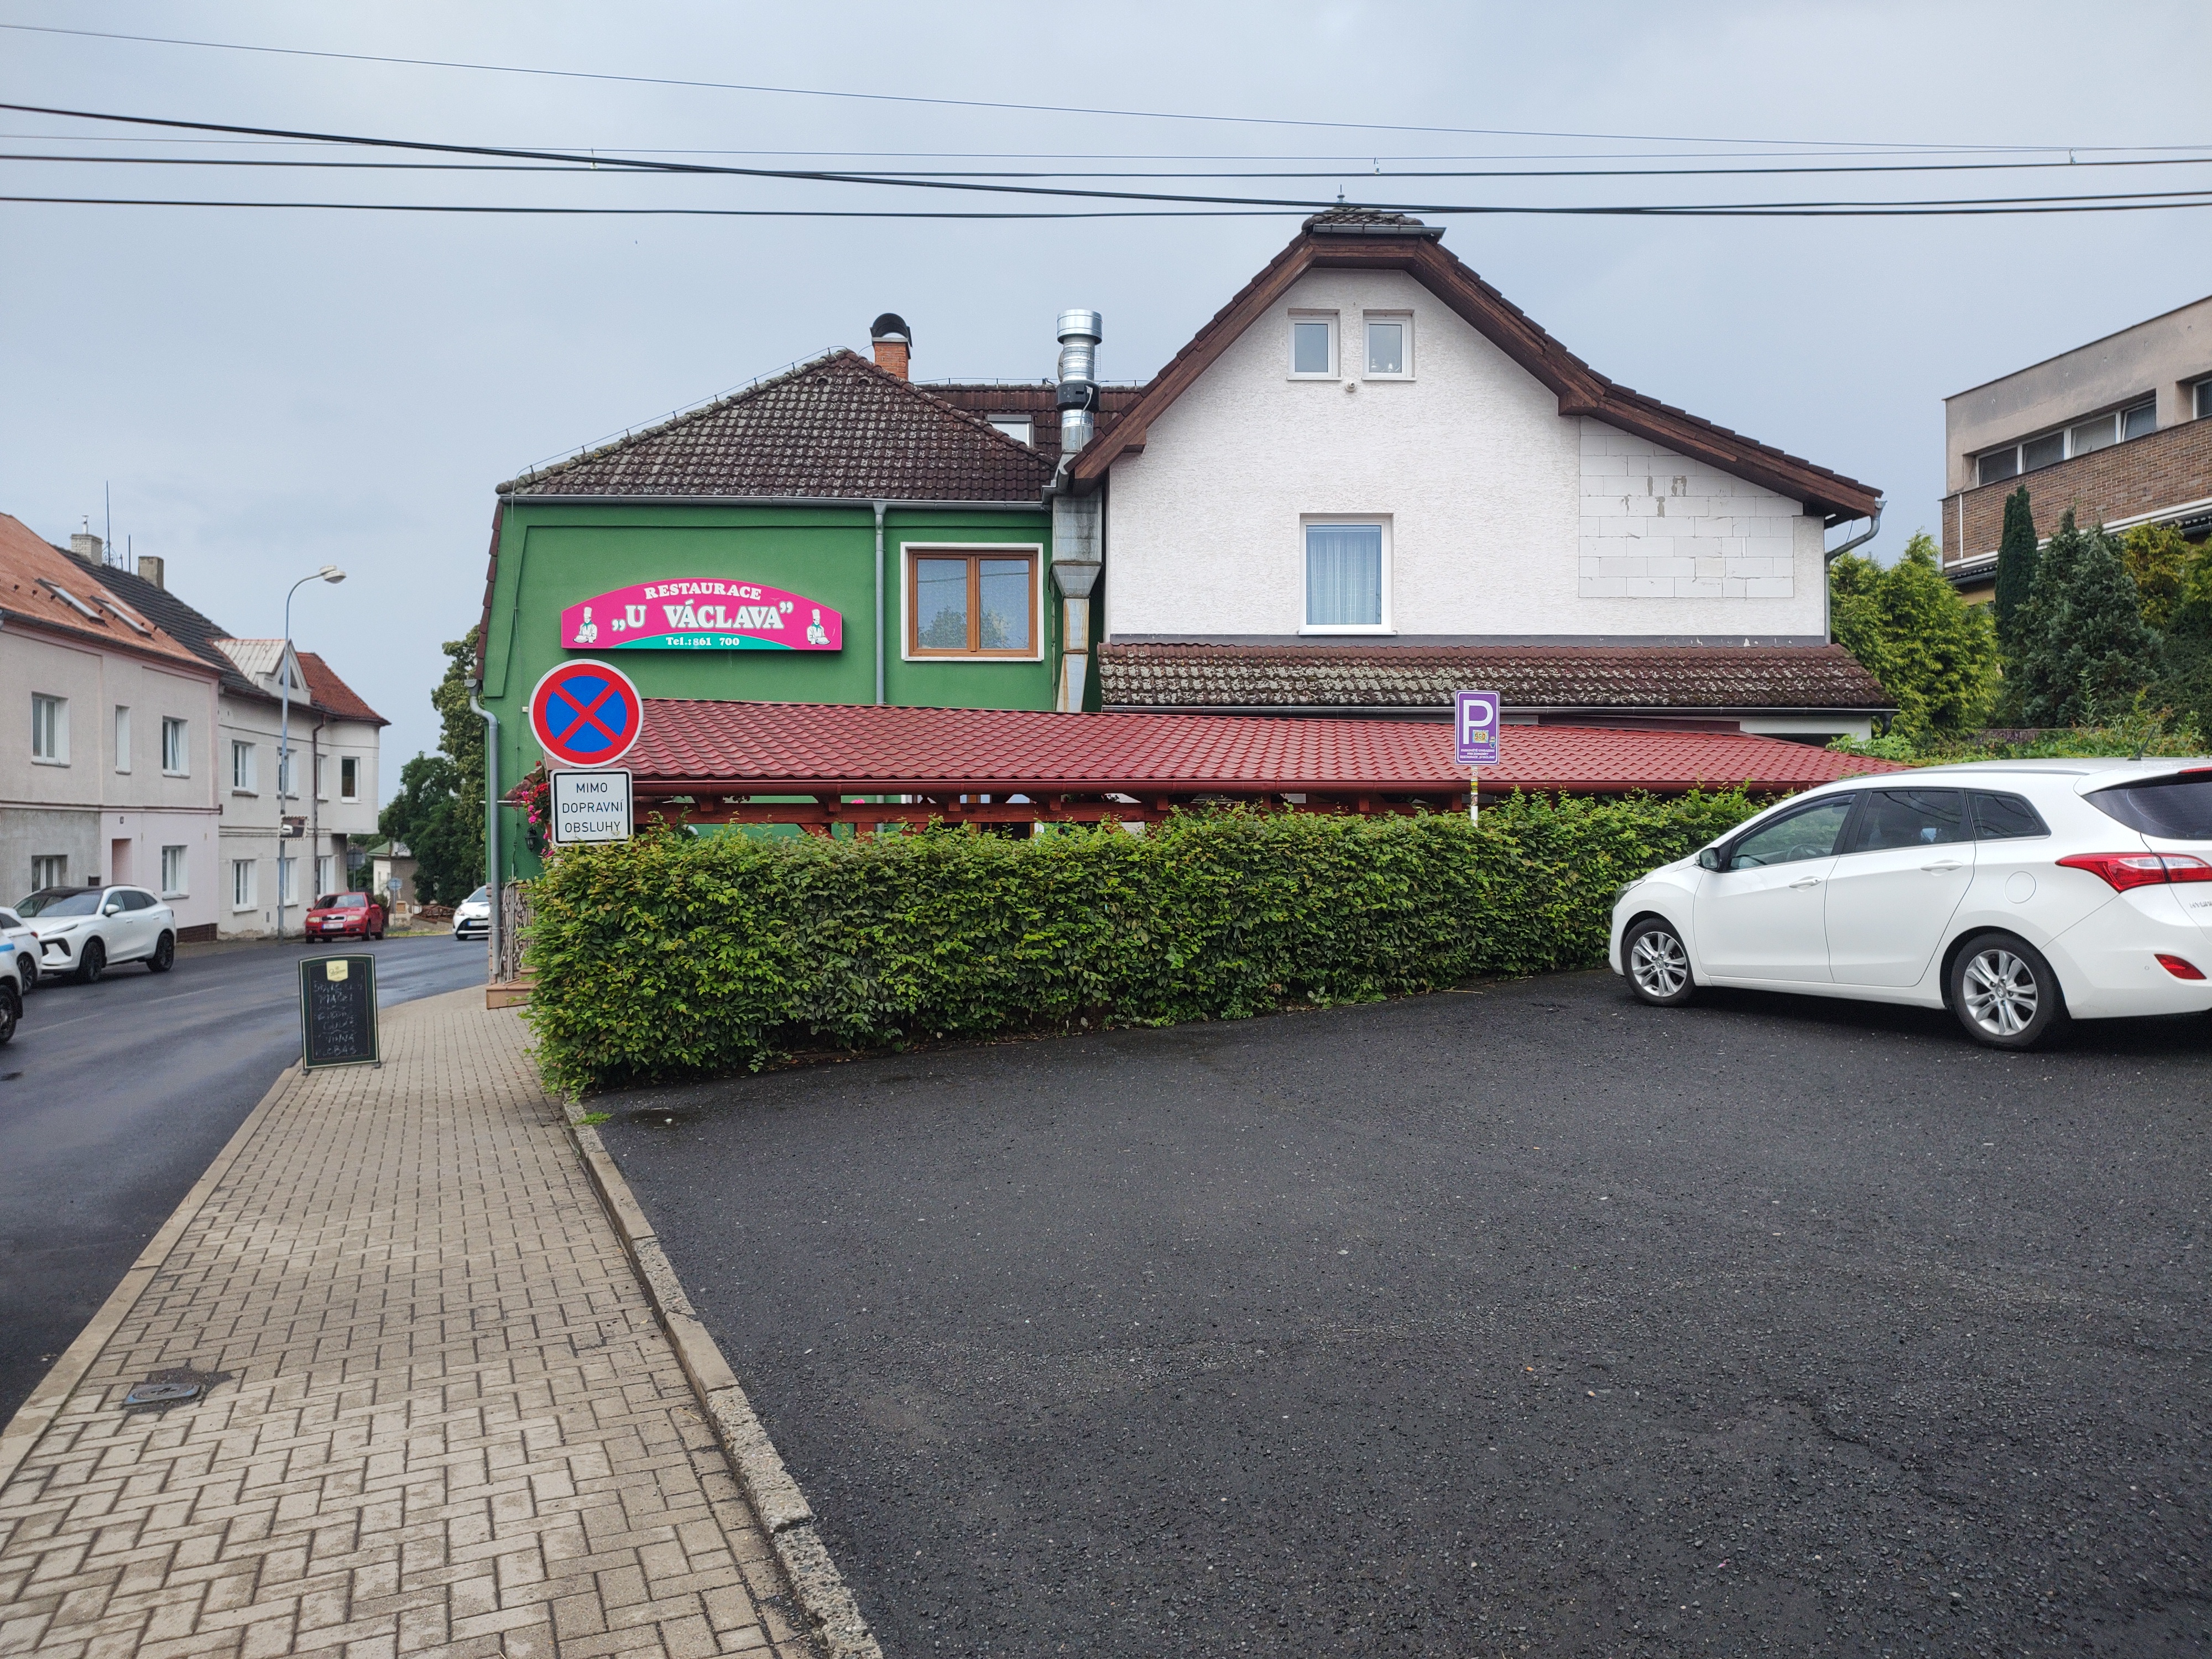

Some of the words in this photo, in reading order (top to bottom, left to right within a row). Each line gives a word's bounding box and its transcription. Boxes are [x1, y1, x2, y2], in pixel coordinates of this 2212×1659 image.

[644, 582, 761, 600] RESTAURACE
[719, 637, 740, 646] 700
[1463, 700, 1493, 744] P
[576, 782, 608, 794] MIMO
[562, 799, 624, 813] DOPRAVNÍ
[565, 821, 620, 833] OBSLUHY
